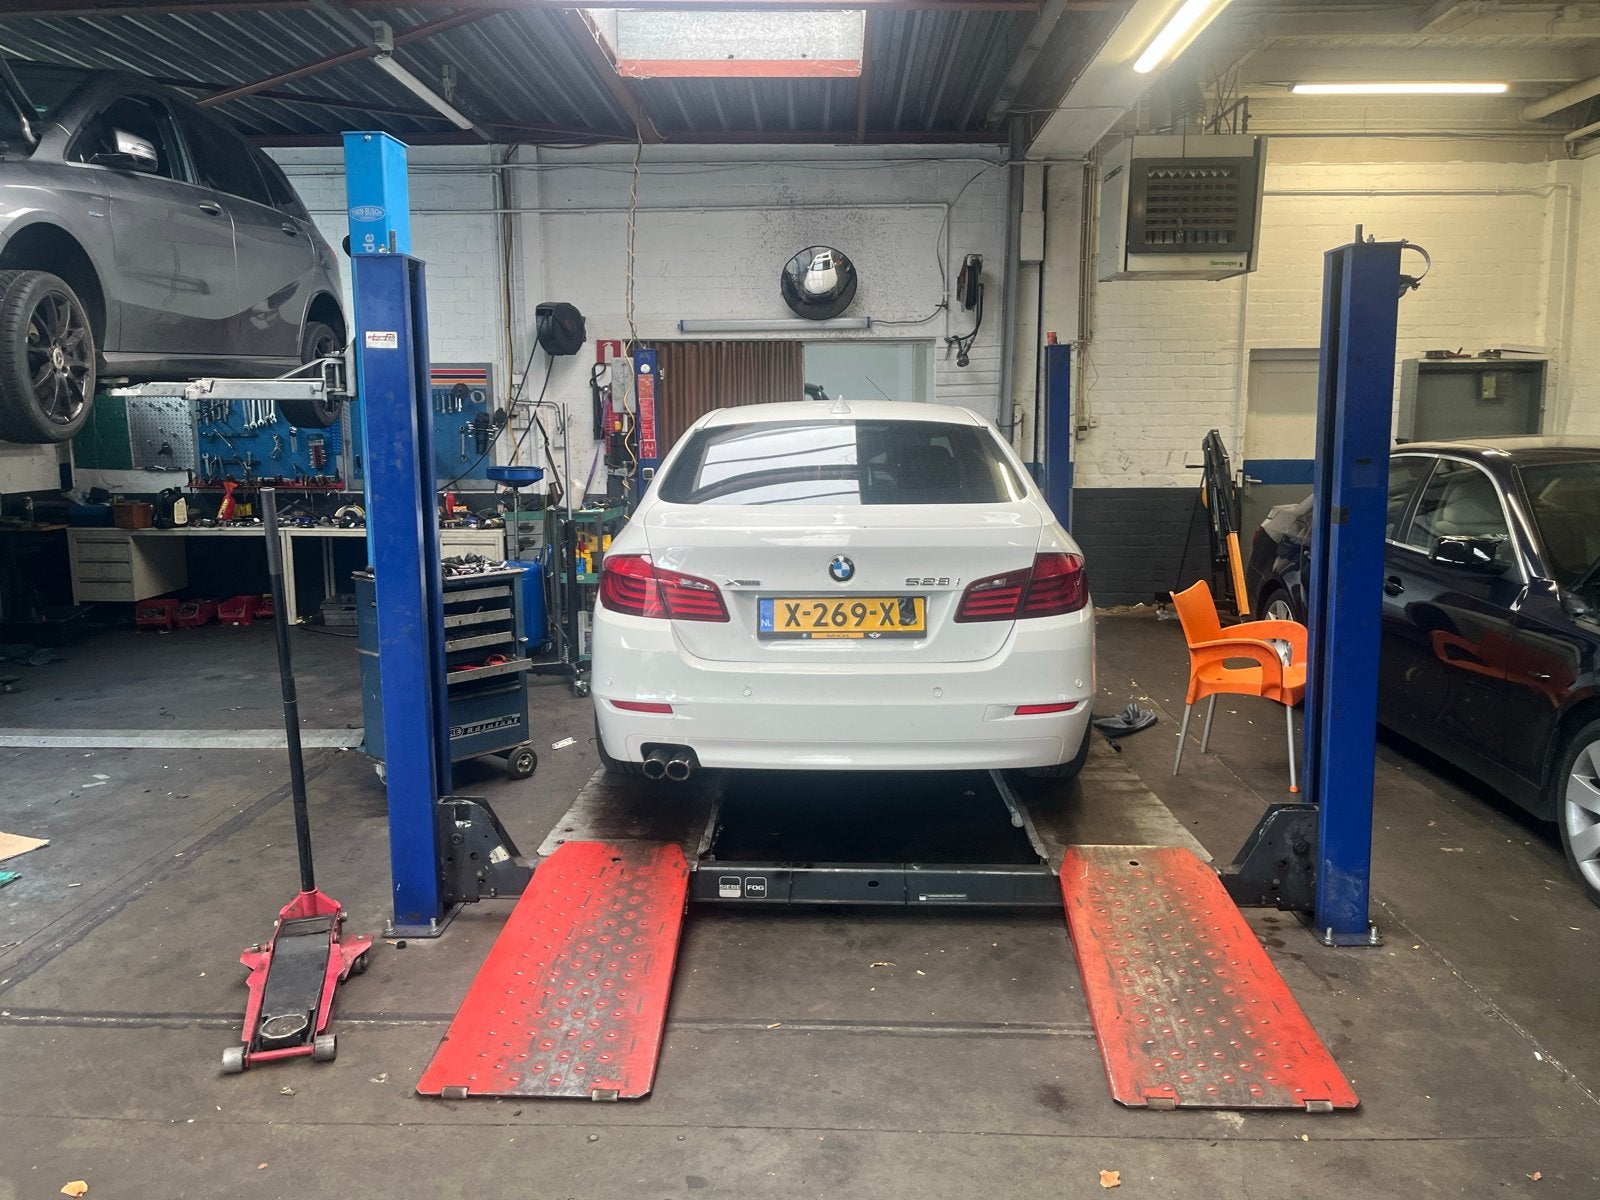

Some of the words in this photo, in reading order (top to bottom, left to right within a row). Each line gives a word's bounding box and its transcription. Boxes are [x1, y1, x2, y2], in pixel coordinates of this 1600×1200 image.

[362, 233, 375, 252] de
[761, 619, 772, 627] NL
[785, 602, 917, 627] X-269-X
